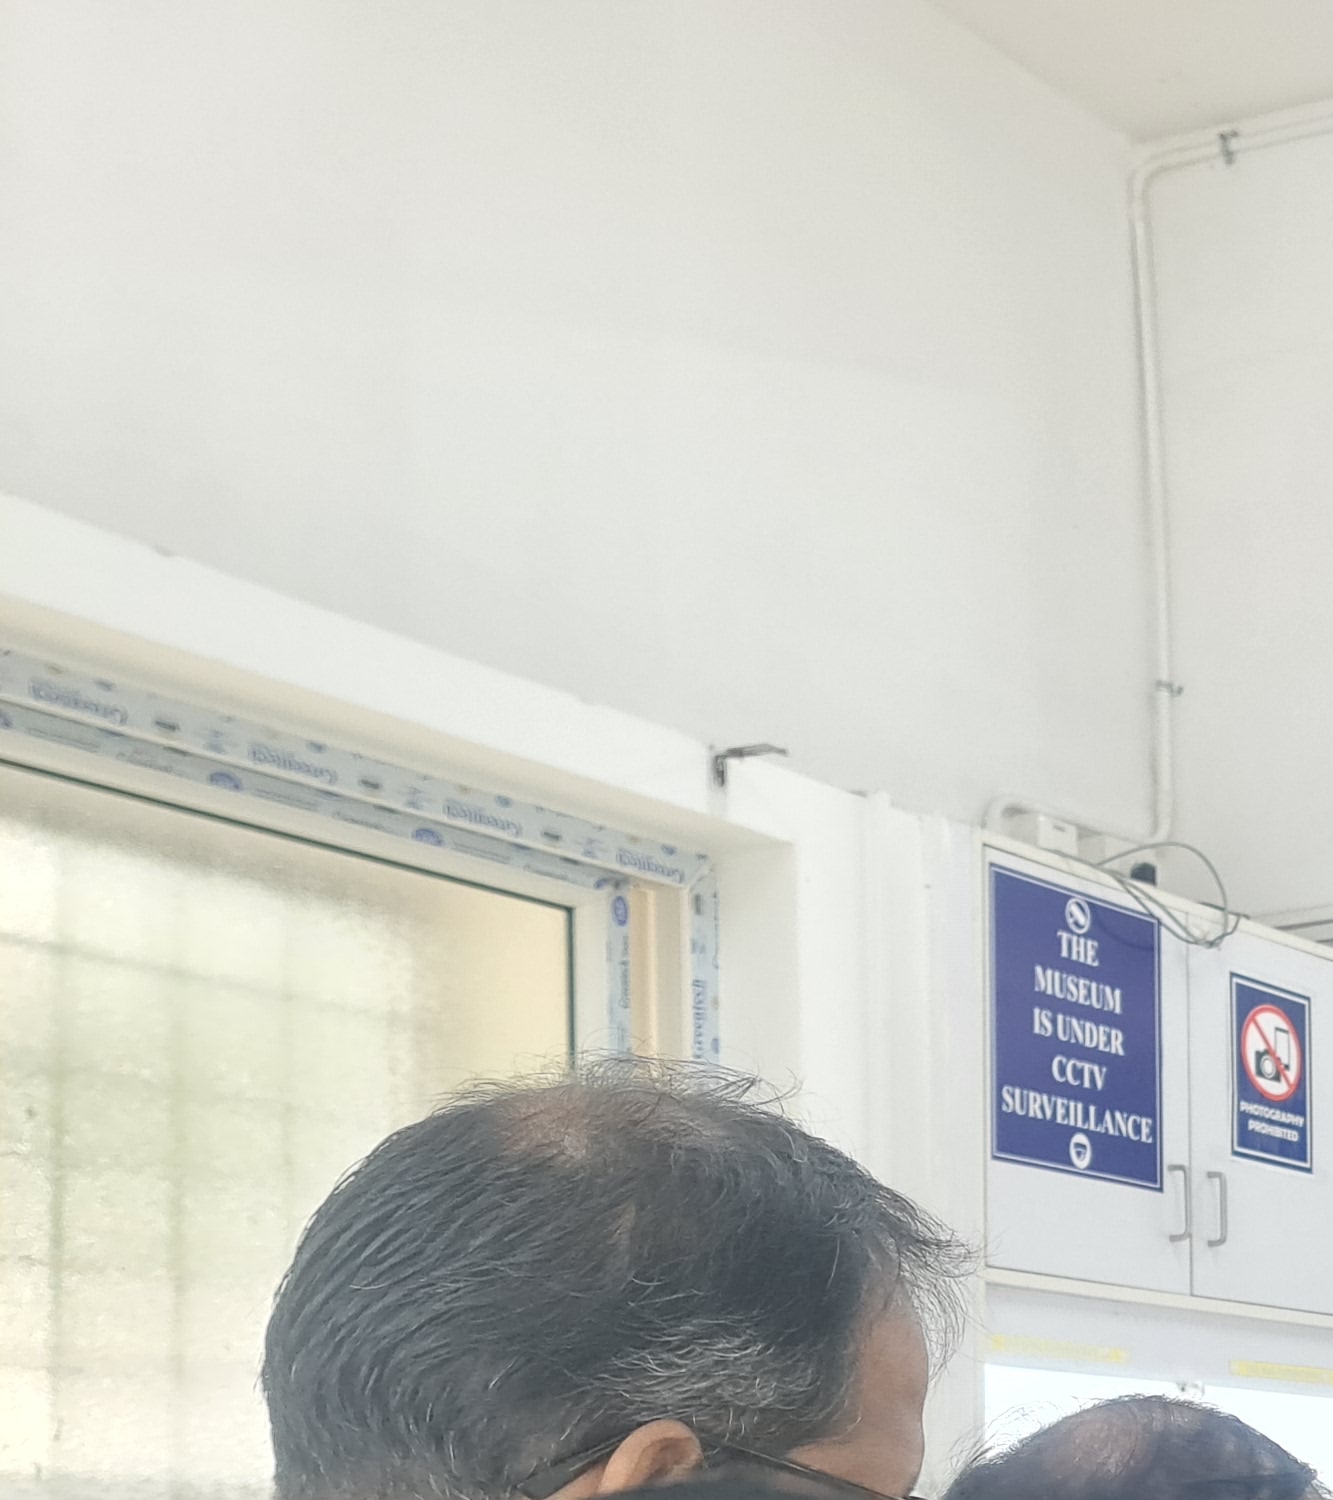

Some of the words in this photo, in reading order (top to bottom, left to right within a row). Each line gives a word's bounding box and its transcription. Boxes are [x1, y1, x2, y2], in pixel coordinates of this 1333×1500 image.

[1057, 929, 1099, 967] THE
[1034, 964, 1122, 1015] MUSEUM
[1032, 1006, 1052, 1037] IS
[1057, 1014, 1125, 1056] UNDER
[1051, 1055, 1107, 1091] CCTV
[1001, 1084, 1153, 1144] SURVEILLANCE
[1239, 1100, 1305, 1128] PHOTOGRAPHY
[1248, 1119, 1299, 1143] PROHIBITED
